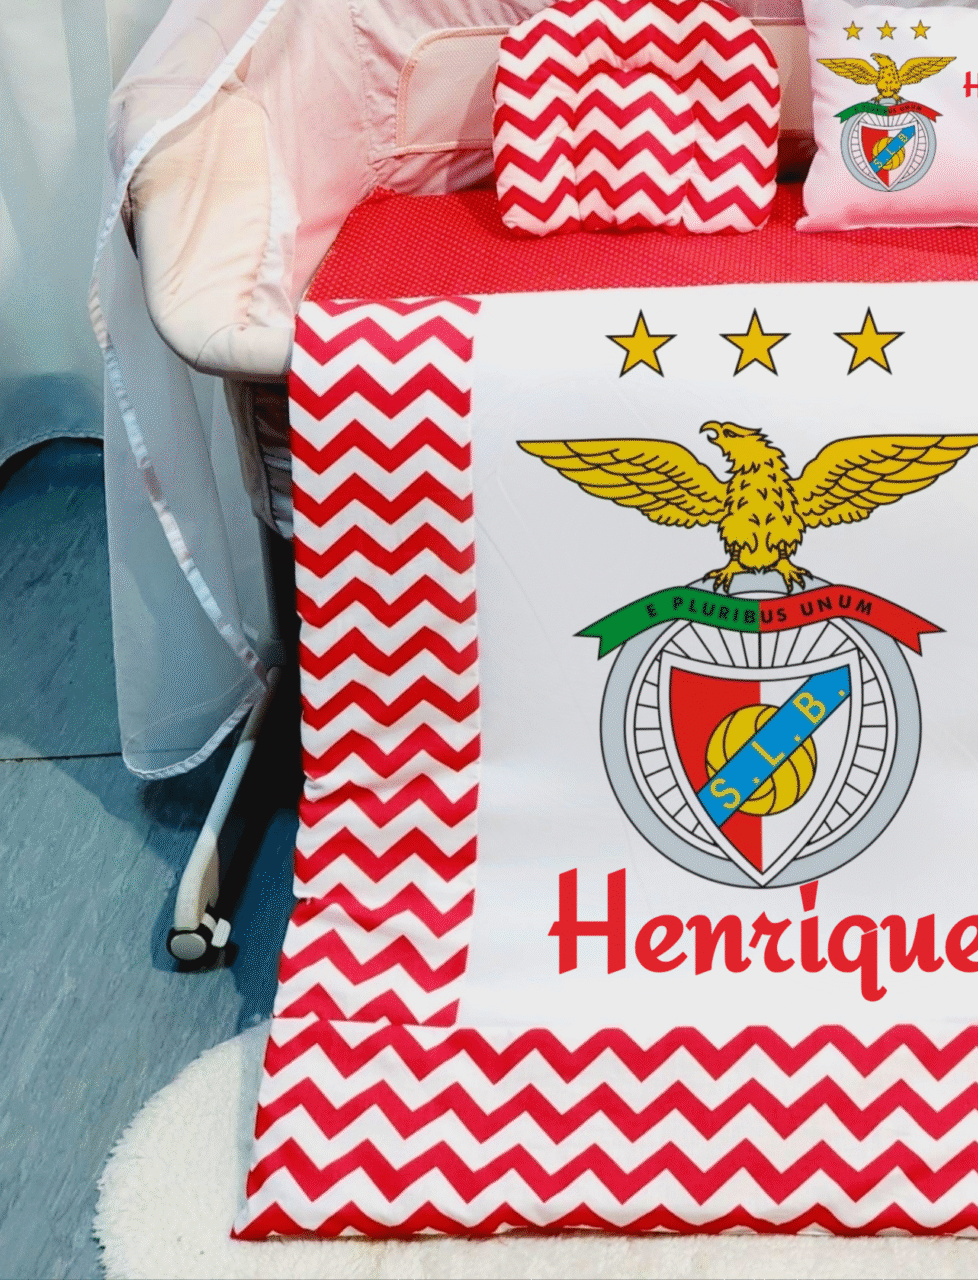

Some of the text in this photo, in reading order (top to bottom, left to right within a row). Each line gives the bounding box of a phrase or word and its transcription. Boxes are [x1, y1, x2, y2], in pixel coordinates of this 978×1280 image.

[646, 594, 873, 624] E PLURIBUS UNUM
